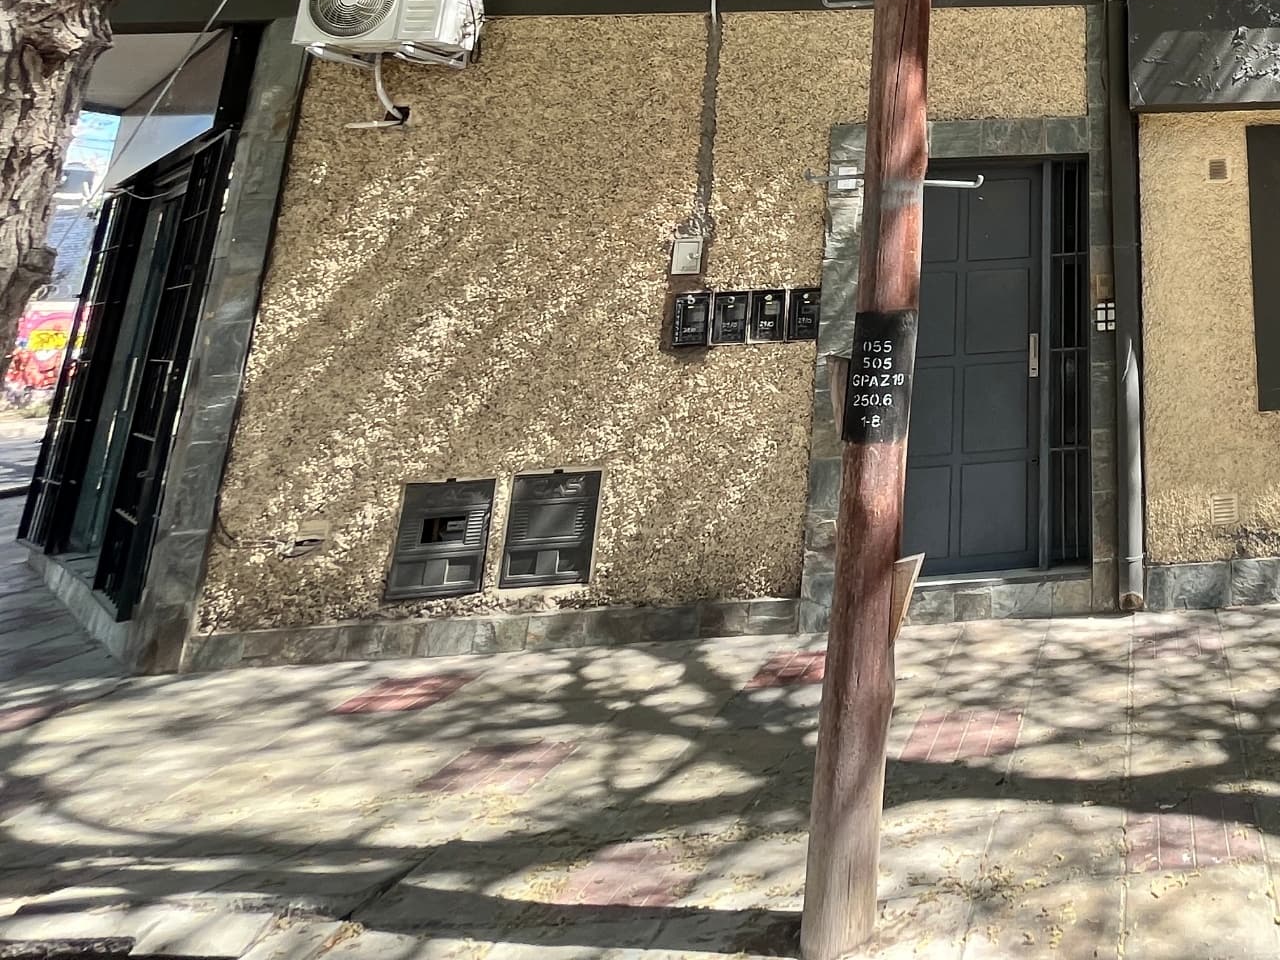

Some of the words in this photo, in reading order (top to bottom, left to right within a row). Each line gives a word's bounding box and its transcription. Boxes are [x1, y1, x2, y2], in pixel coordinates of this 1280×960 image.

[863, 340, 892, 353] 055
[863, 357, 892, 370] 505
[853, 393, 893, 407] 250.6
